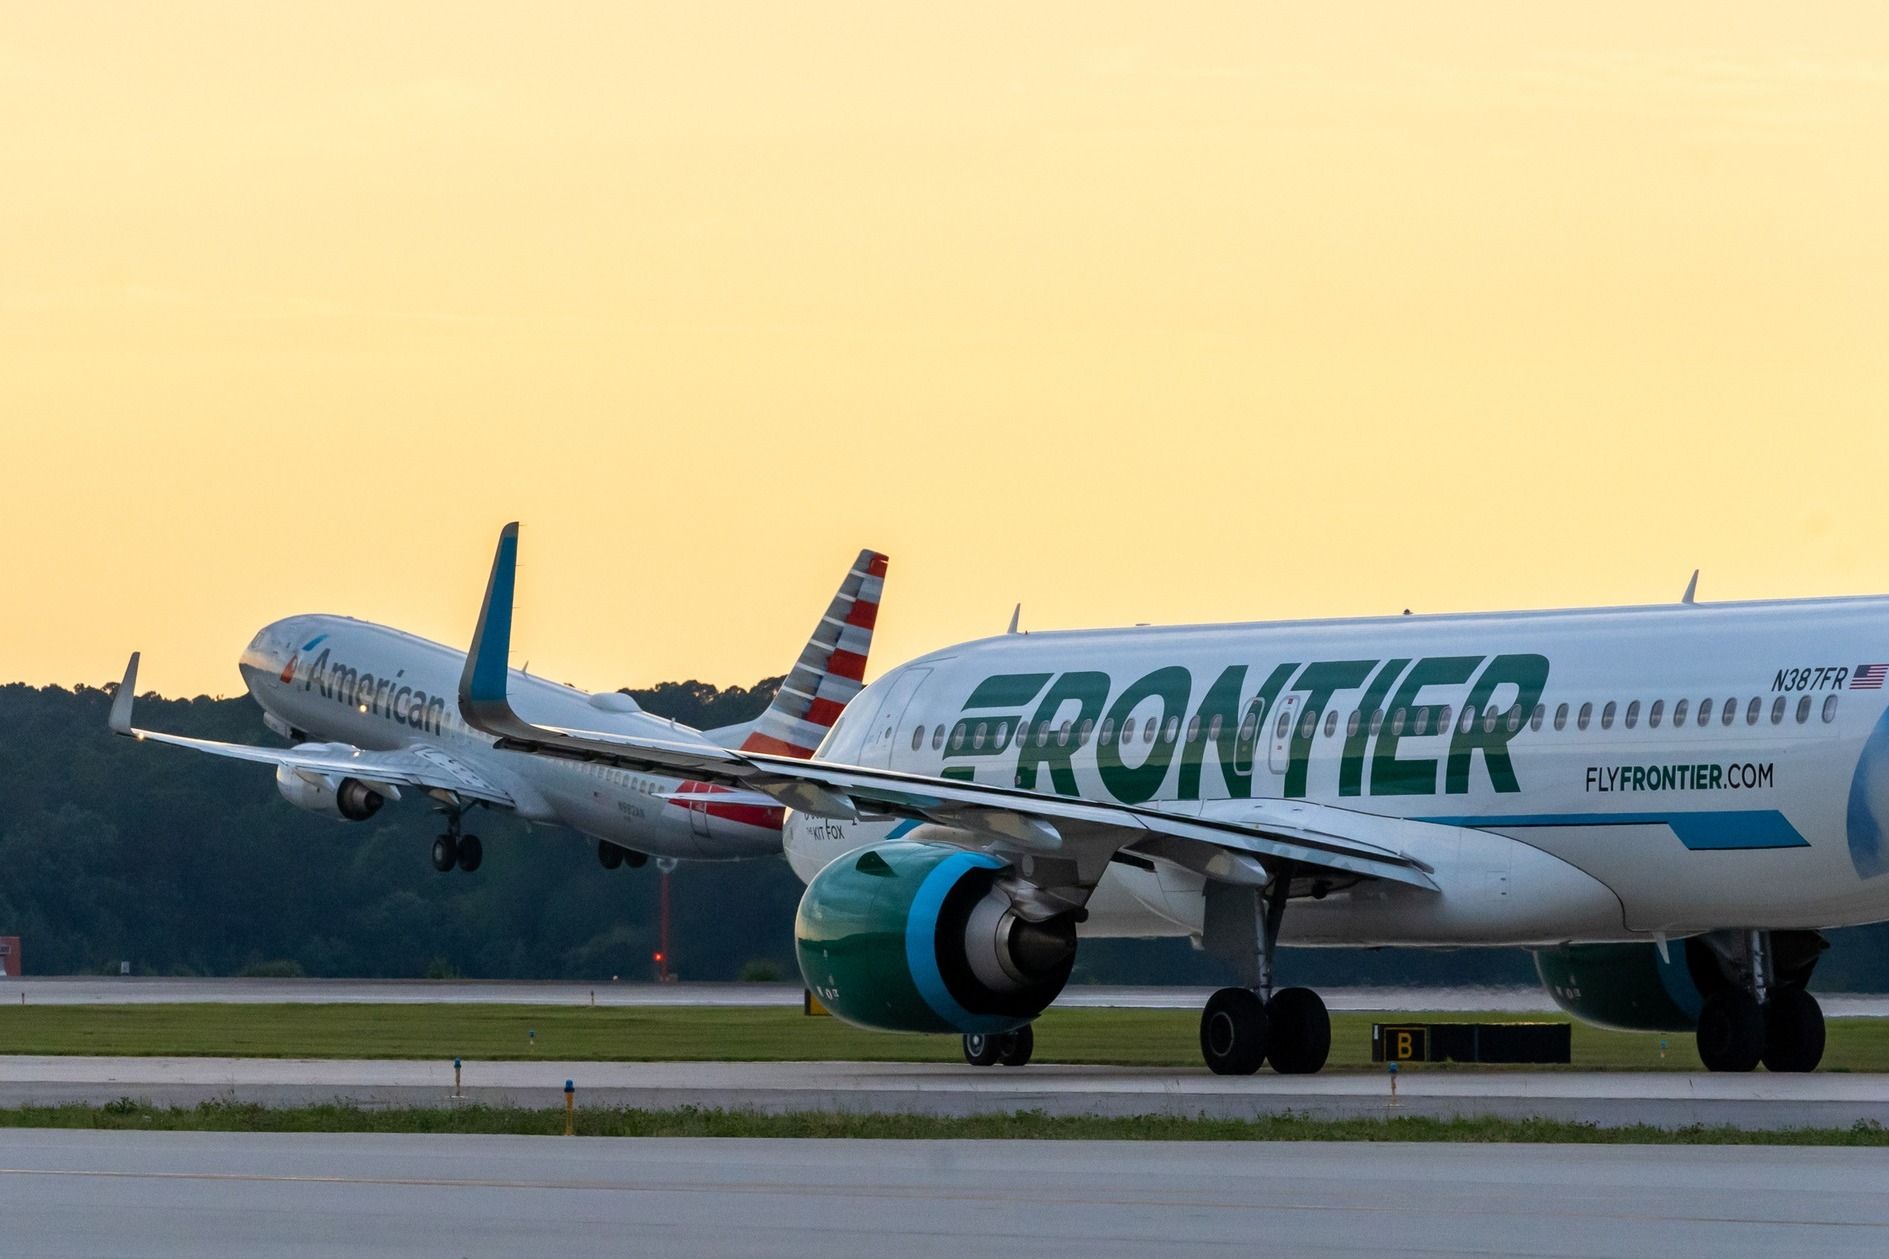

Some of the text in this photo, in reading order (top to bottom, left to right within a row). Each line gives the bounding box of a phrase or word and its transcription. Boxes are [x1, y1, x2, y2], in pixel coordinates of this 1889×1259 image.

[305, 648, 445, 736] American
[1771, 666, 1848, 692] N387FR
[939, 653, 1550, 804] FRONTIER
[1586, 763, 1774, 792] FLYFRONTIER.COM
[826, 824, 845, 840] FOX
[1398, 1032, 1412, 1059] B
